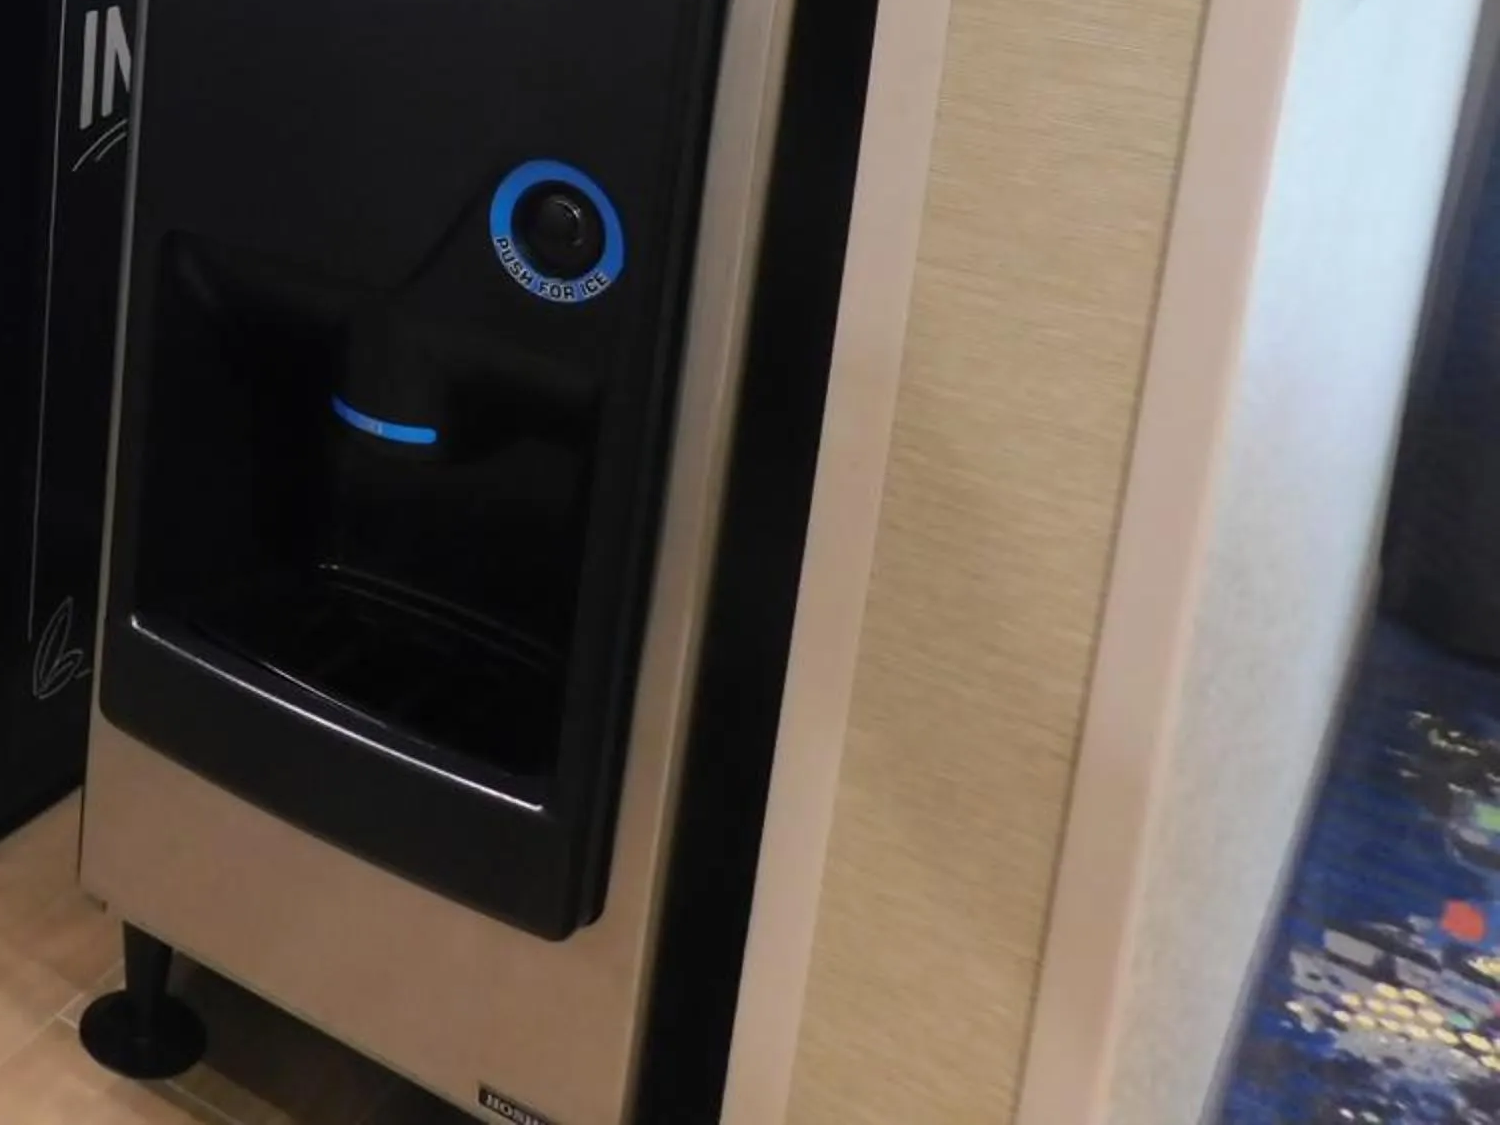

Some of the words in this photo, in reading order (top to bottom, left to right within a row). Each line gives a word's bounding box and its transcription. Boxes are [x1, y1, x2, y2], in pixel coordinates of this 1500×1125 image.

[496, 237, 534, 285] PUSH
[538, 282, 576, 300] FOR
[579, 271, 608, 296] ICE
